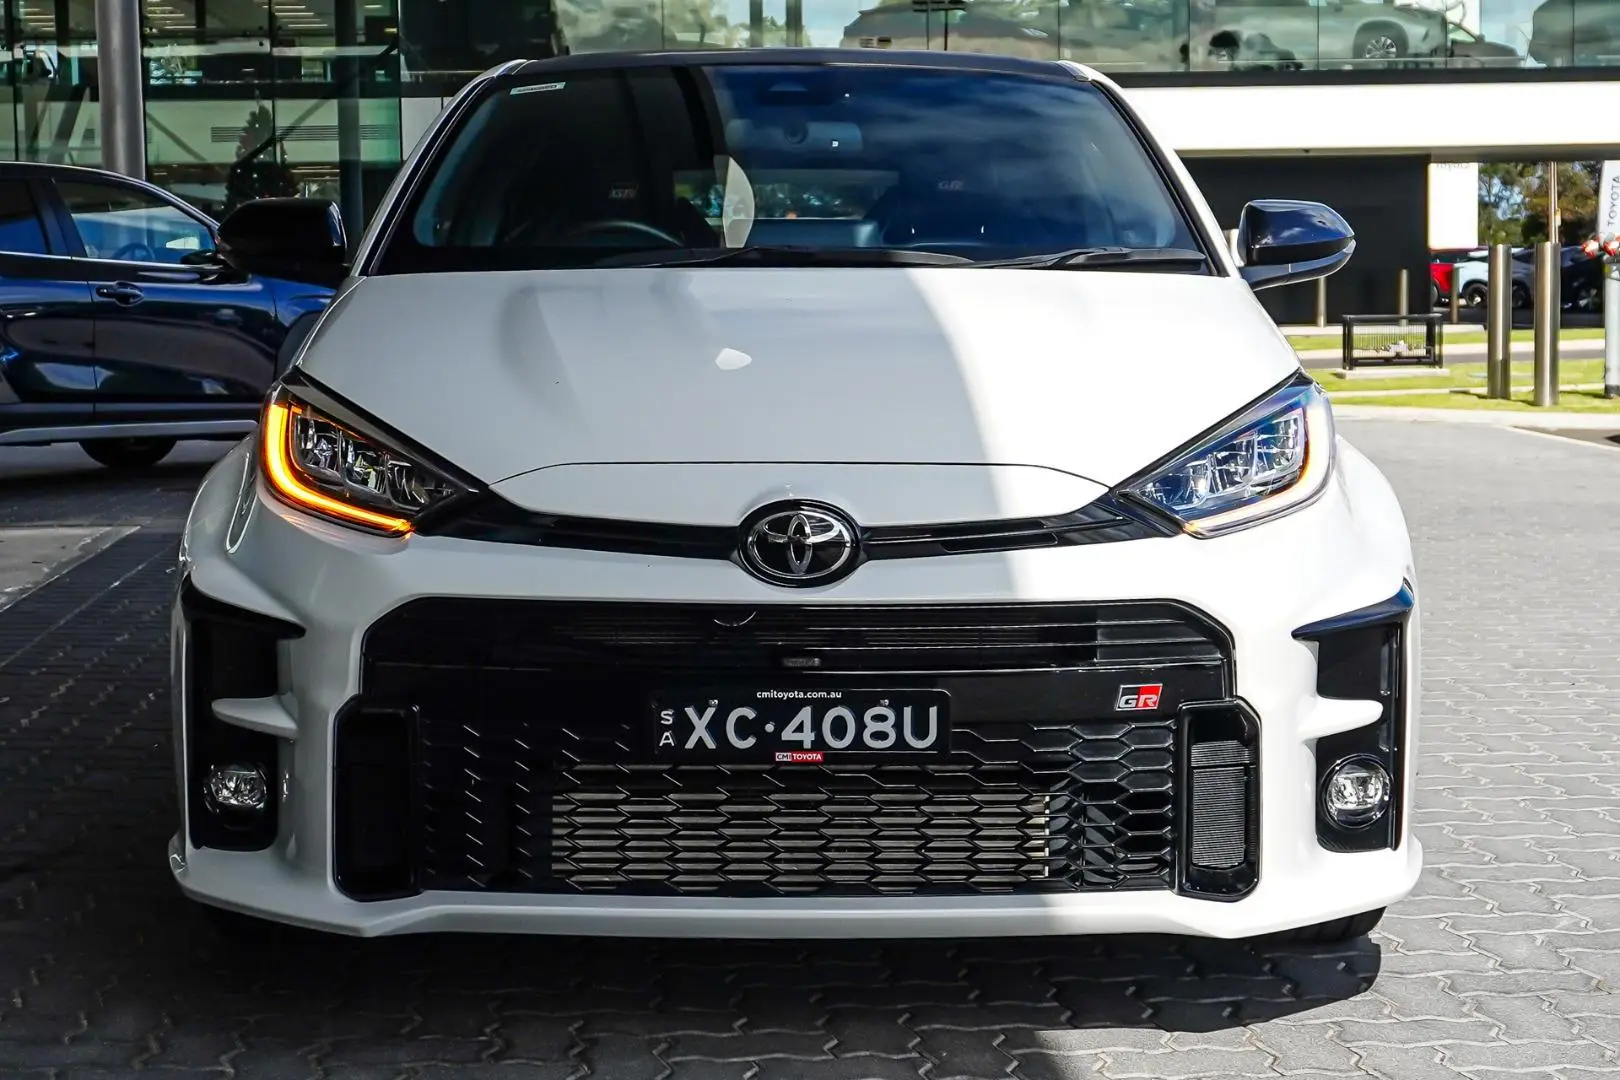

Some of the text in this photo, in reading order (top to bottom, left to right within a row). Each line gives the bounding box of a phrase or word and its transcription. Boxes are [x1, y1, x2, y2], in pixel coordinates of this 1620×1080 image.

[1607, 175, 1620, 227] TOYOTA
[756, 690, 842, 700] cmitoyota.com.au
[792, 753, 822, 761] TOYOTA
